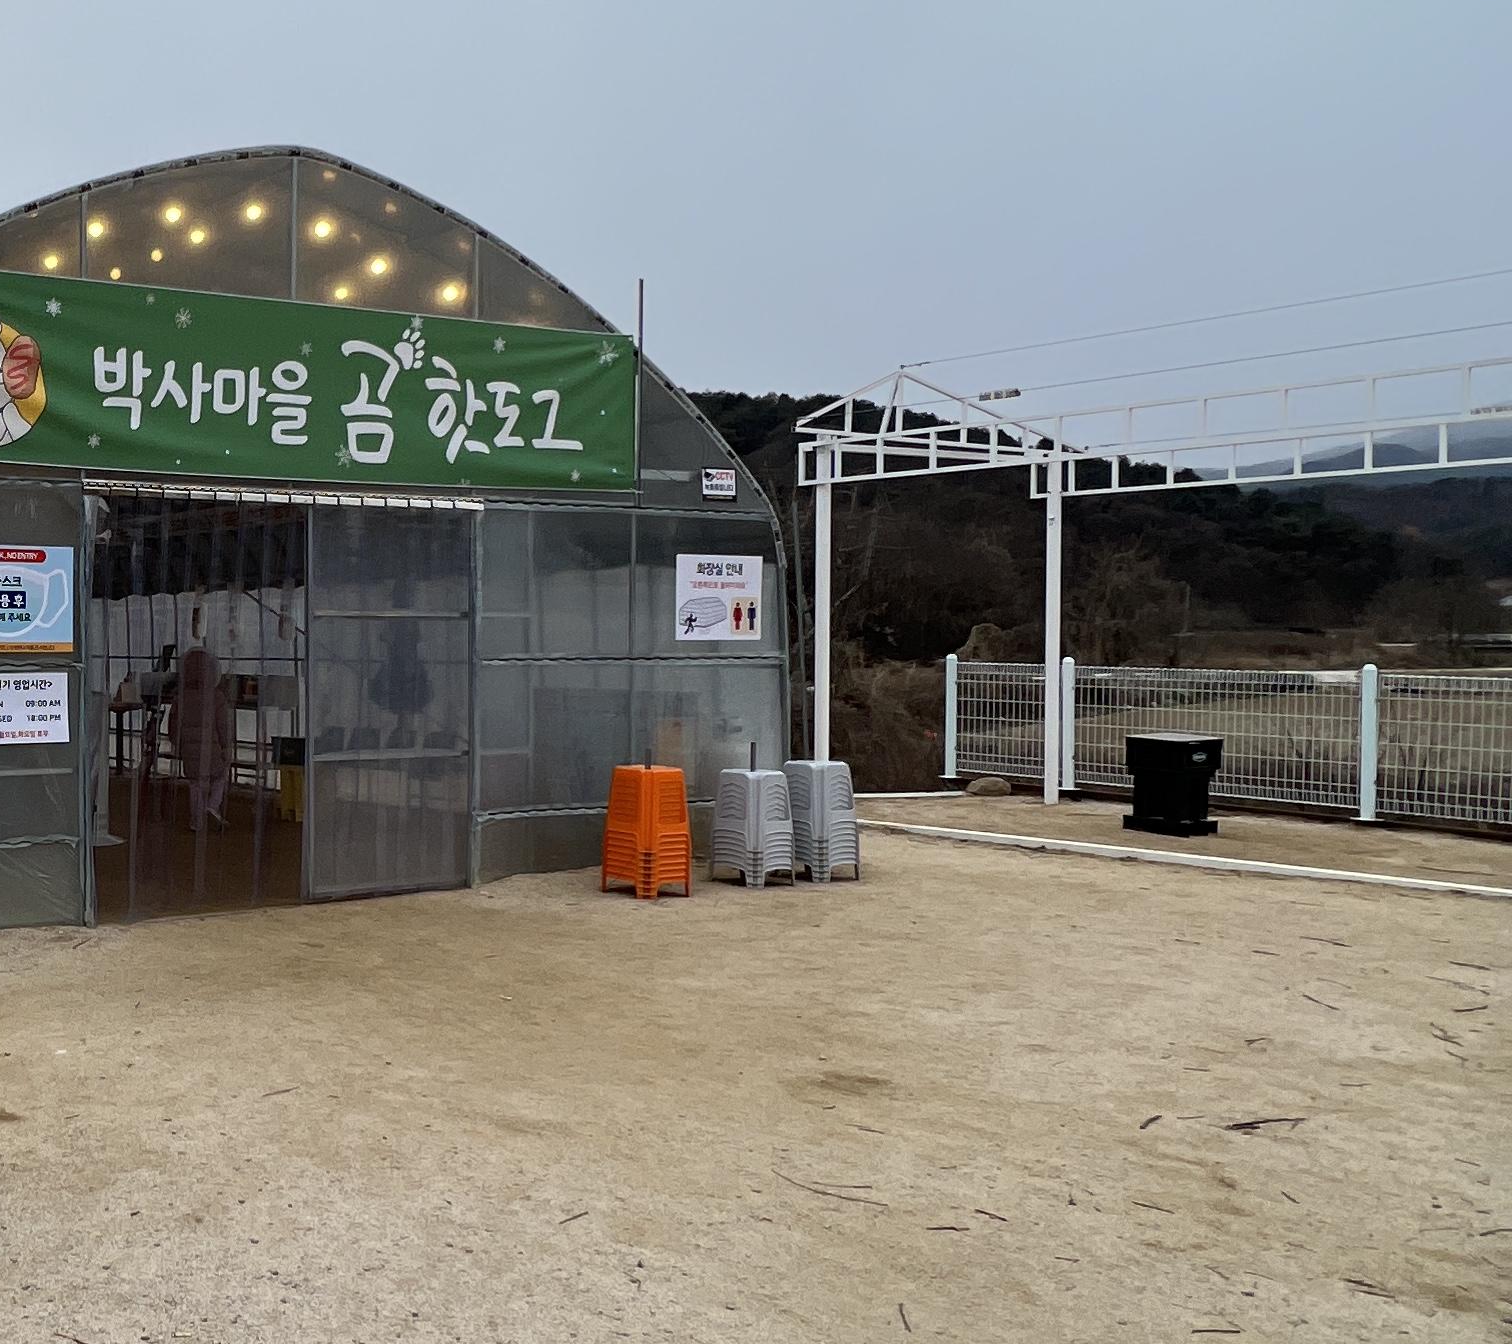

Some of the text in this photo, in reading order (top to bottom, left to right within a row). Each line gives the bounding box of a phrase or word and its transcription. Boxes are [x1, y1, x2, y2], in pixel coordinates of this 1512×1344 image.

[93, 339, 583, 464] 박사마을 곰 핫도그
[715, 471, 734, 481] CCTV
[696, 562, 744, 577] 화장실 안내
[12, 593, 25, 608] 후
[7, 612, 31, 623] 주세요
[25, 699, 48, 708] 09:00
[48, 699, 61, 707] AM
[49, 714, 61, 722] PM
